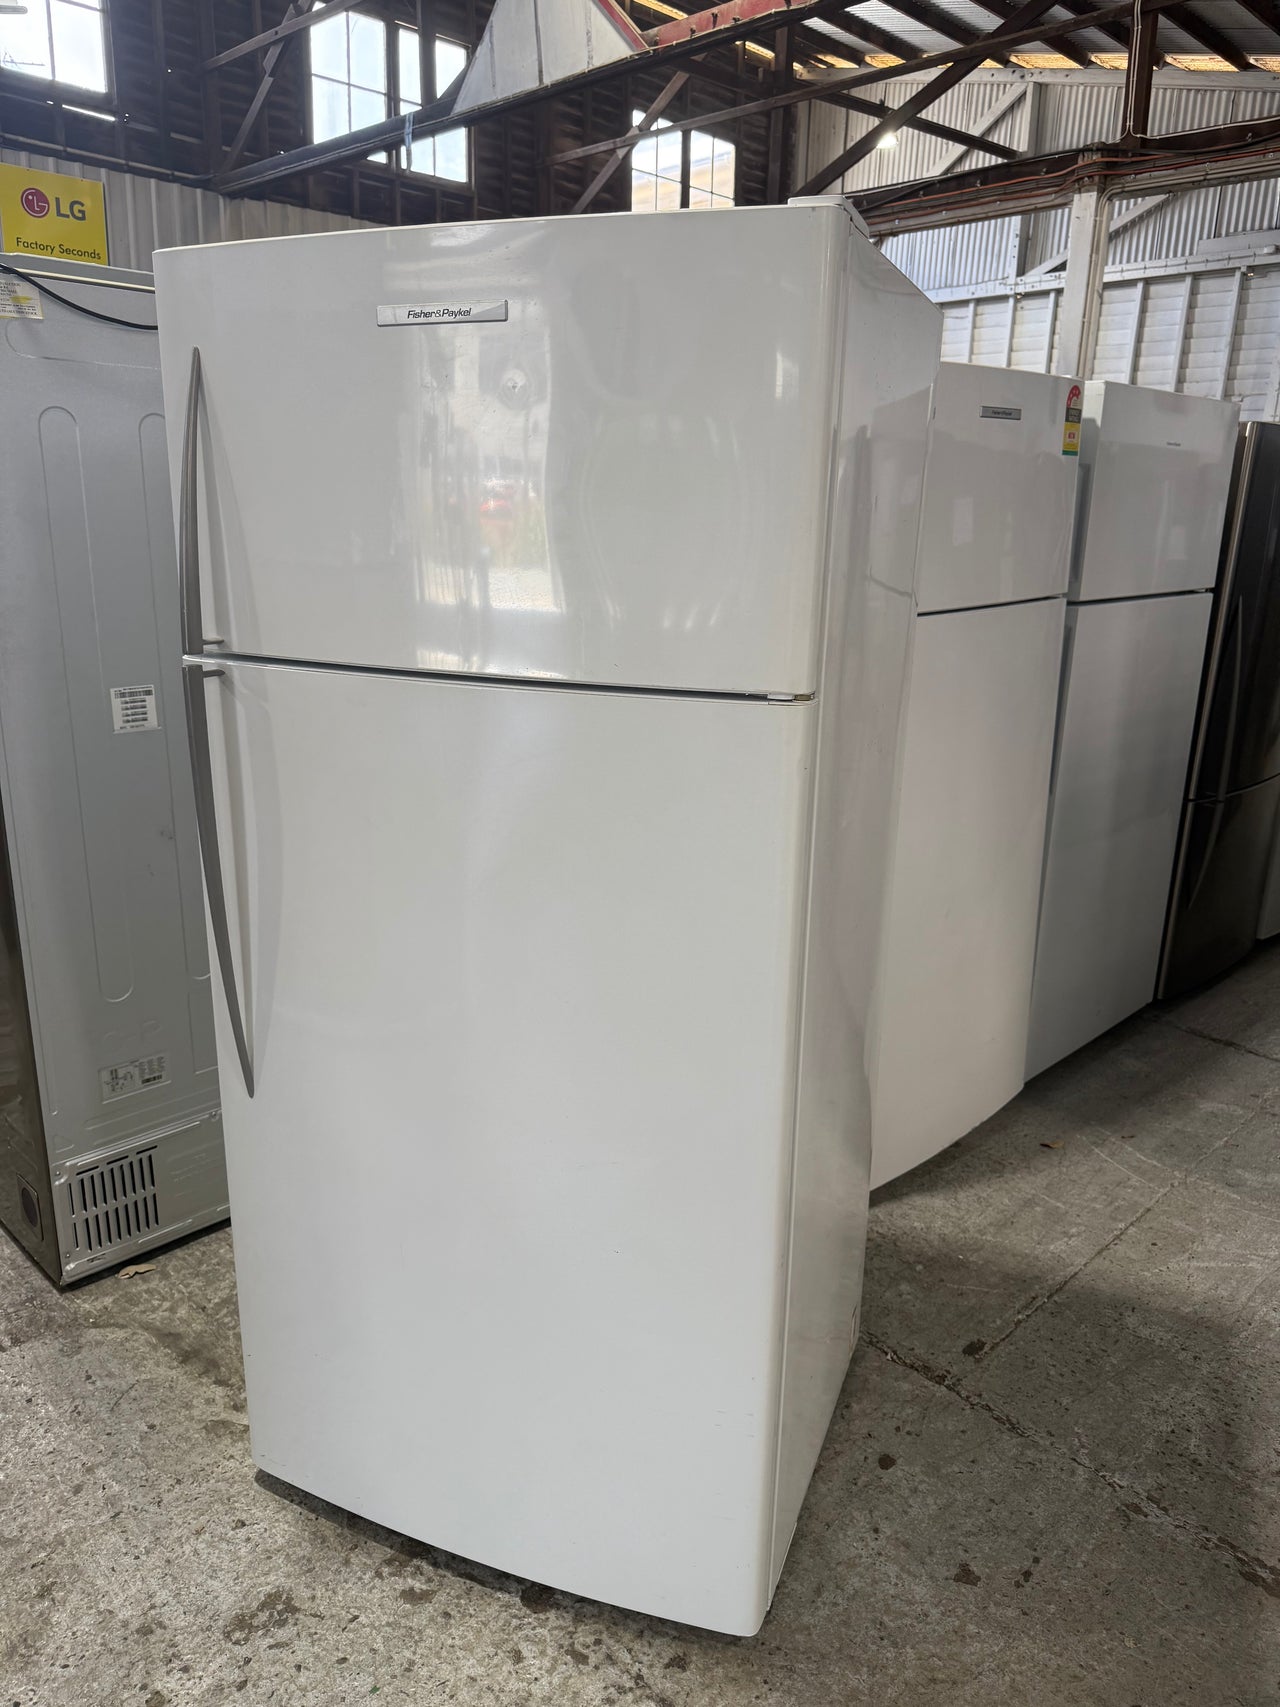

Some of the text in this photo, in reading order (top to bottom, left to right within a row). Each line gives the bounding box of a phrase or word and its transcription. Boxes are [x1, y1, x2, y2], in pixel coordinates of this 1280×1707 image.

[55, 197, 86, 221] LG
[16, 237, 102, 260] Factory Seconds
[407, 307, 472, 319] Fisher&Paykel
